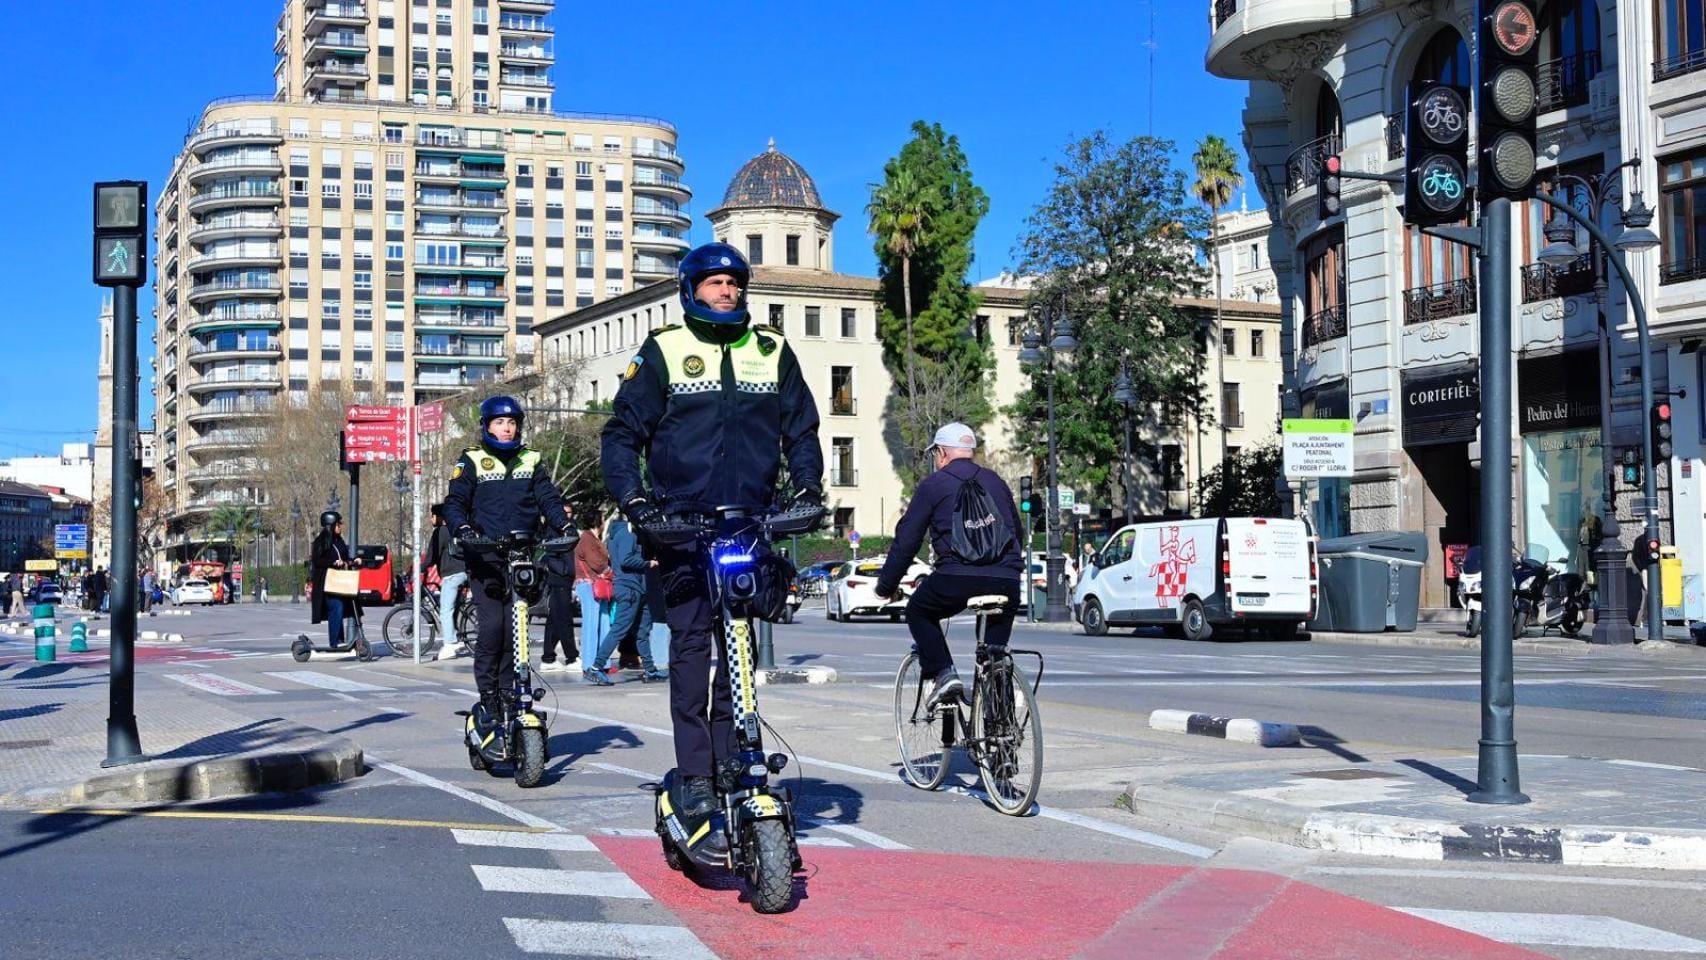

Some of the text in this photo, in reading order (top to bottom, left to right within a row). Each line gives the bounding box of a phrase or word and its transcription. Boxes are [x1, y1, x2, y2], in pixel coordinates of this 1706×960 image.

[1409, 385, 1472, 405] CORTEFIEL
[1527, 405, 1552, 422] Pedro
[1553, 402, 1568, 419] del
